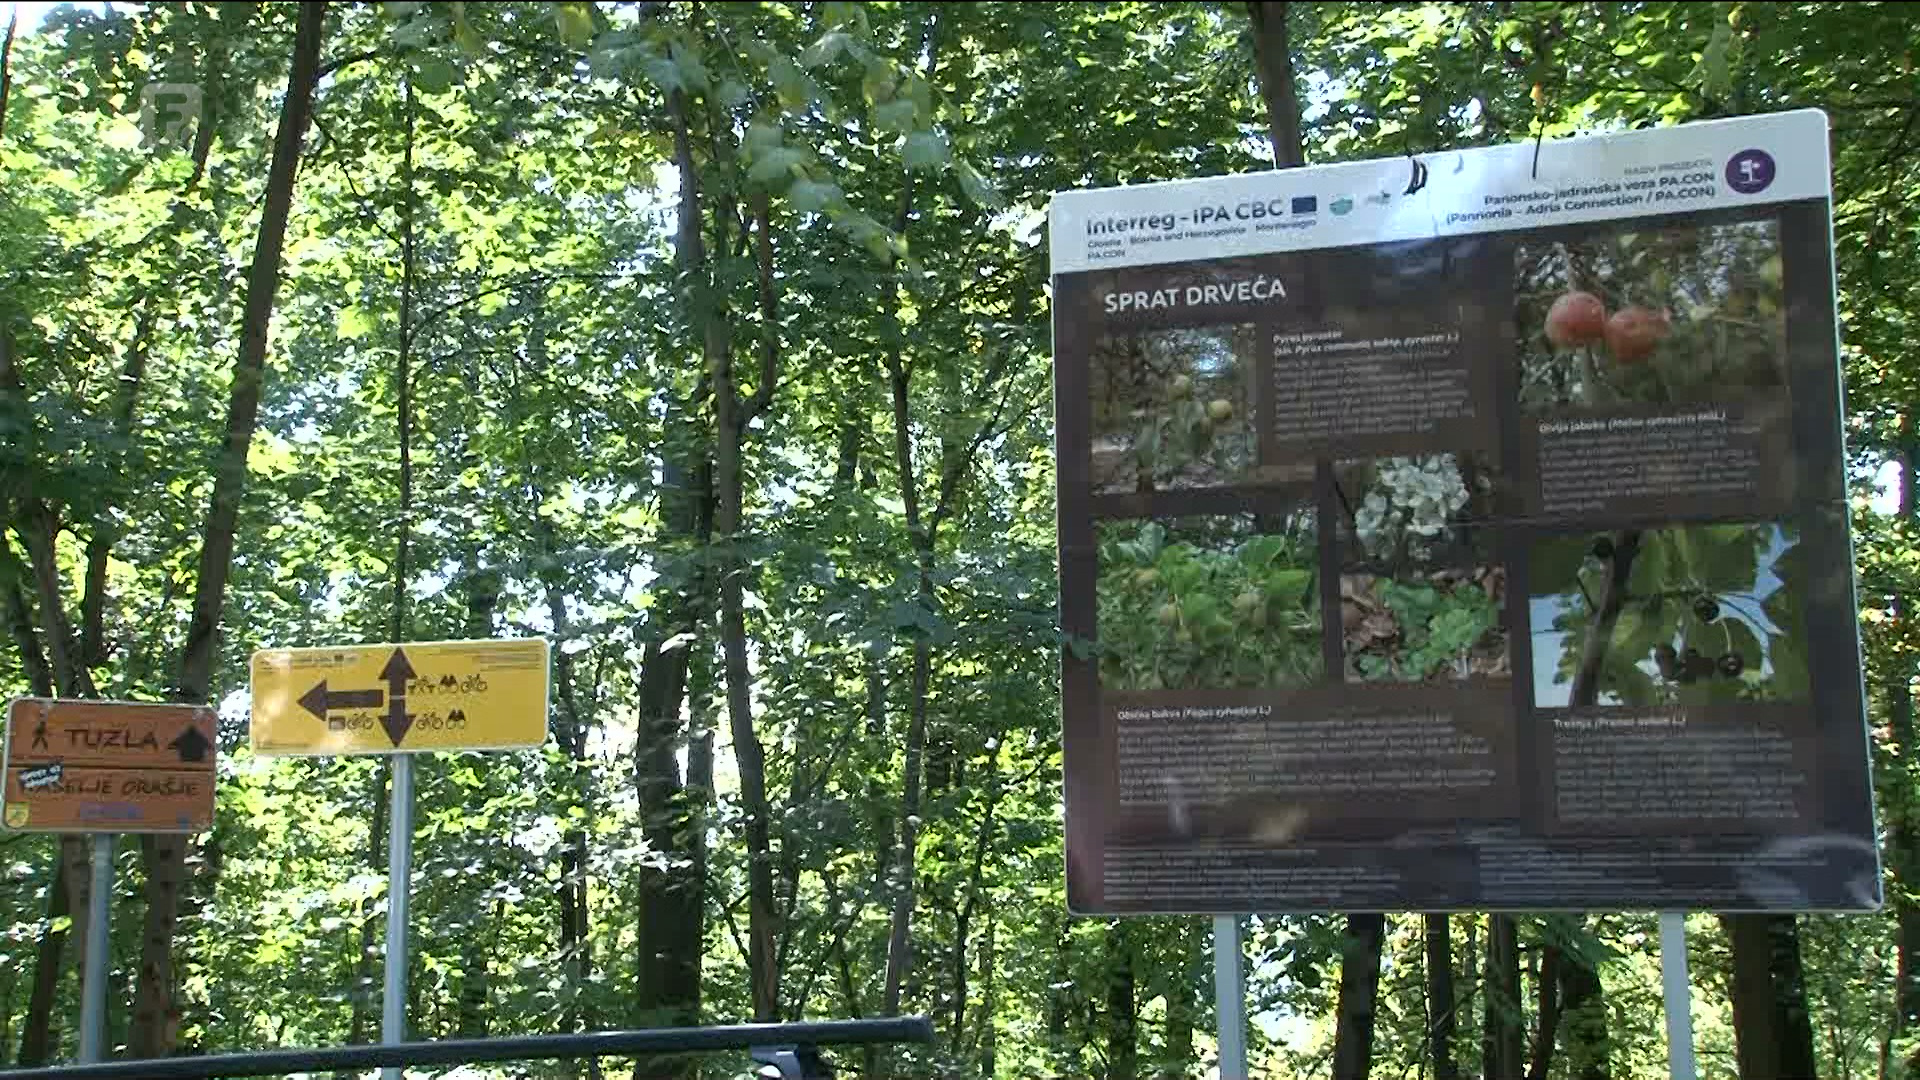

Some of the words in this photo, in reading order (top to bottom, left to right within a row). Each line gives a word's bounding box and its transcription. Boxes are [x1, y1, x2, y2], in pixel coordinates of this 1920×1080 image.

[1235, 199, 1284, 220] CBC
[1564, 194, 1643, 210] Connection
[1104, 289, 1179, 314] SPRAT
[1186, 275, 1287, 306] DRVEĆA
